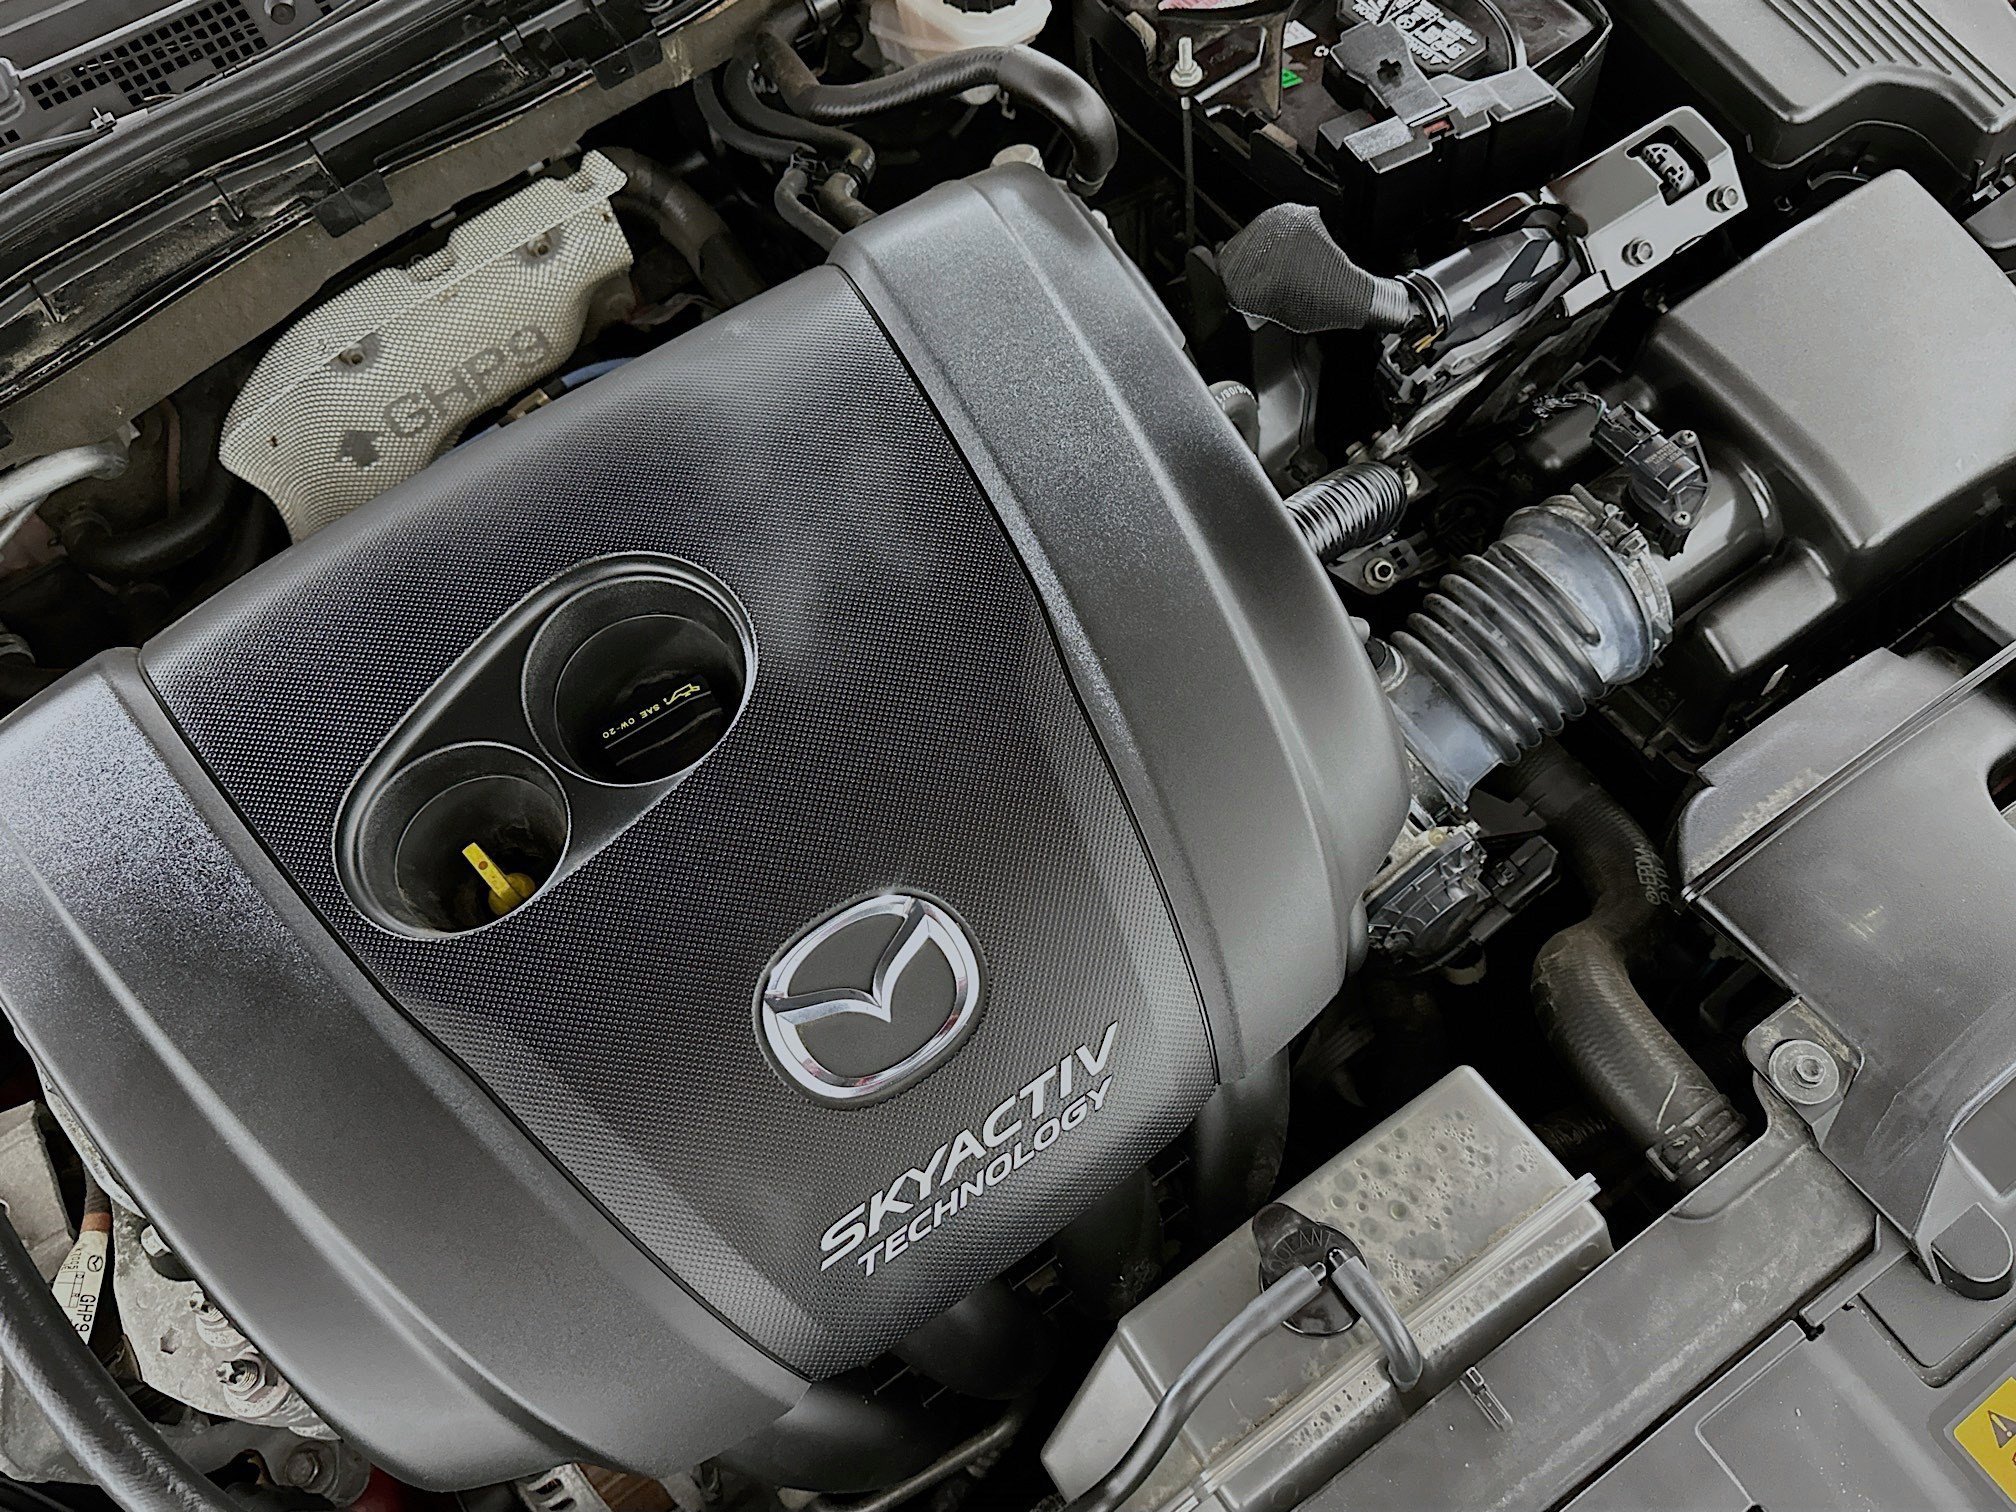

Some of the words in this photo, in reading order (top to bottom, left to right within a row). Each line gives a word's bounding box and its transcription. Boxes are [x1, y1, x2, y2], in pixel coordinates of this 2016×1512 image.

[384, 325, 551, 438] GHP9
[602, 717, 636, 739] 0W-20
[639, 703, 661, 719] SAE
[820, 1020, 1119, 1272] SKYACTIV
[857, 1074, 1114, 1278] TECHNOLOGY
[75, 1294, 97, 1333] GHP9
